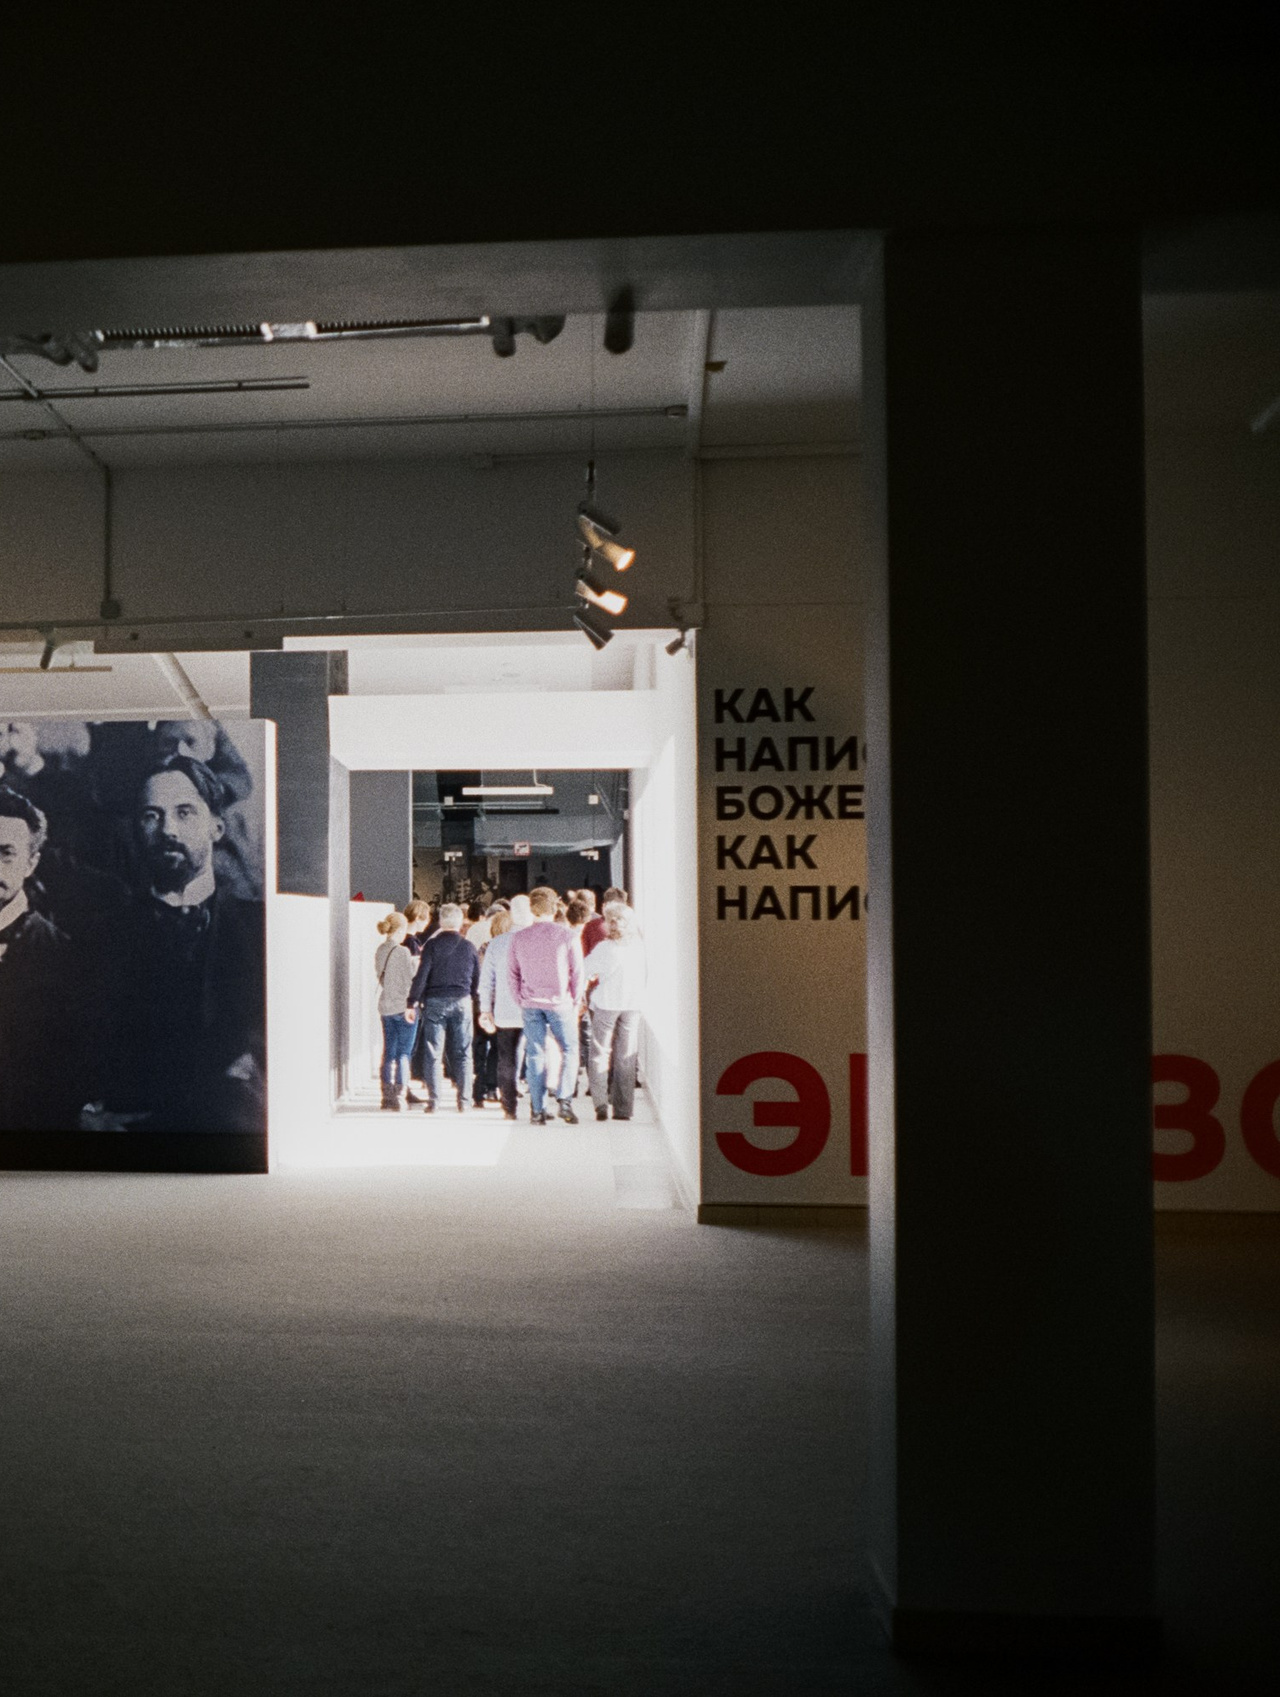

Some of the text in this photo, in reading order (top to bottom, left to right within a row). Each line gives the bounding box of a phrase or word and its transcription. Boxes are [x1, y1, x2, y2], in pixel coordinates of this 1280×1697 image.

[714, 687, 815, 723] КАК
[715, 736, 867, 772] НАПИ
[716, 784, 865, 820] БОЖЕ
[716, 834, 818, 870] КАК
[716, 885, 868, 920] НАПИ
